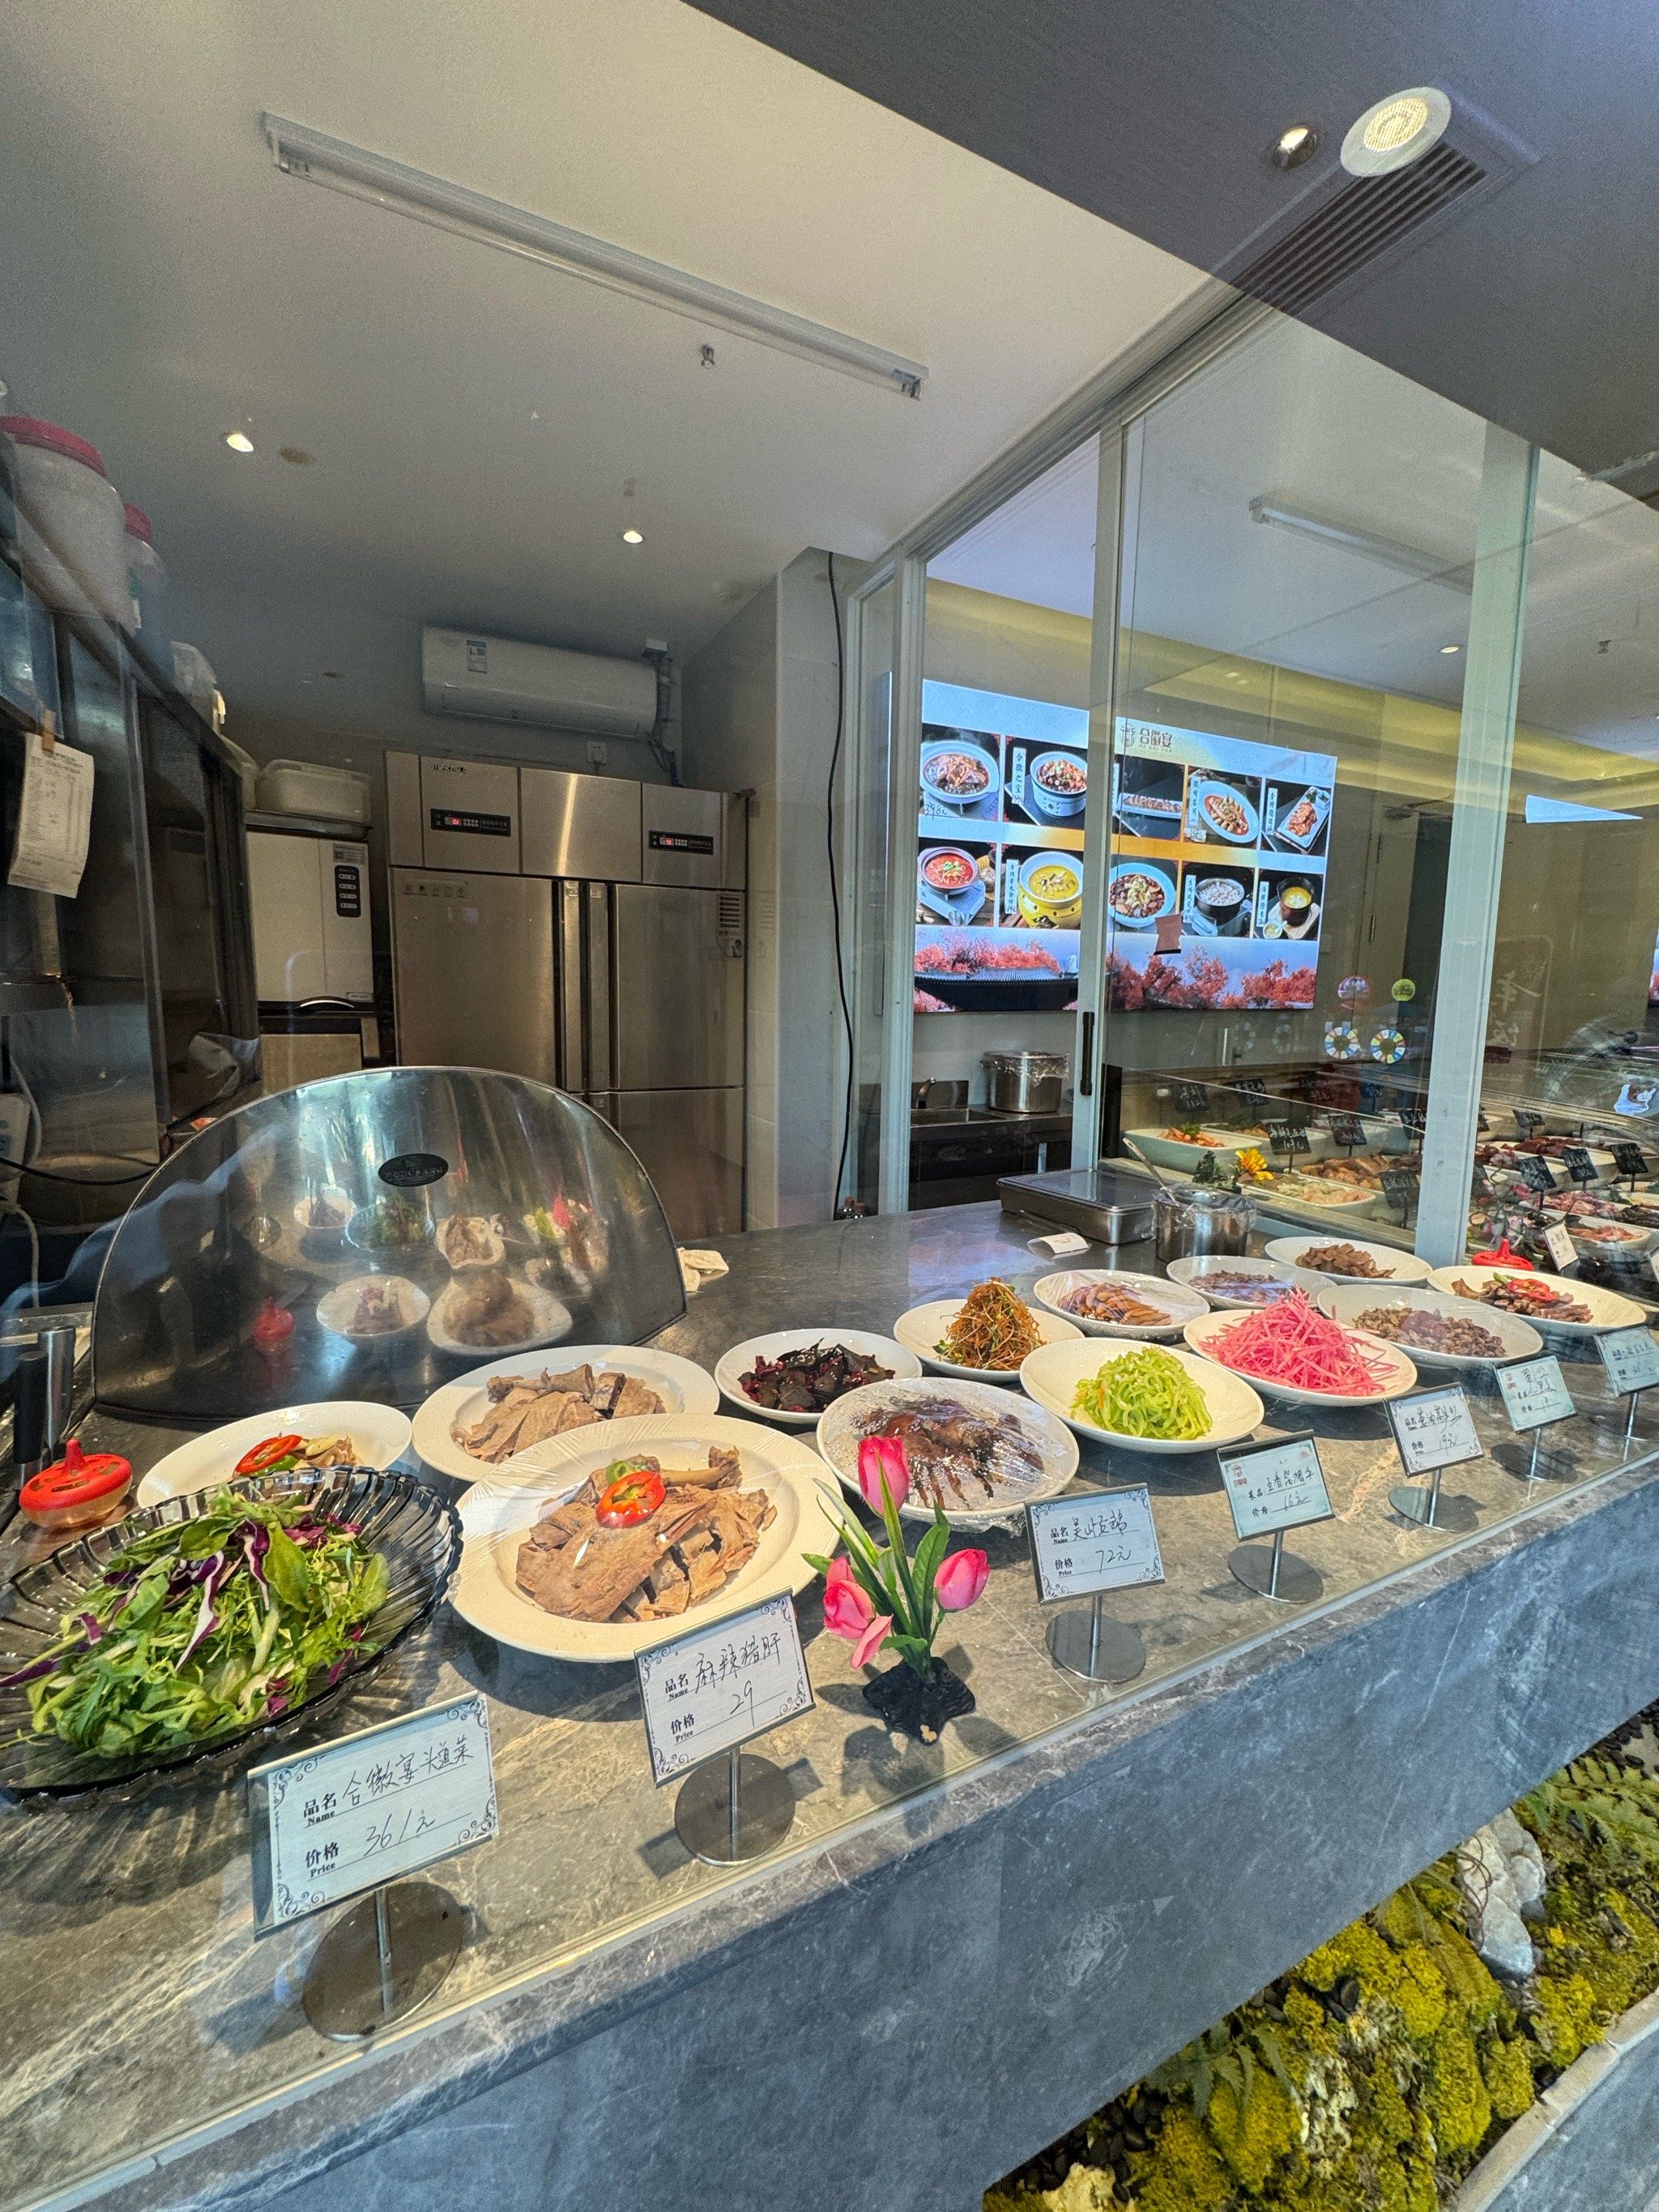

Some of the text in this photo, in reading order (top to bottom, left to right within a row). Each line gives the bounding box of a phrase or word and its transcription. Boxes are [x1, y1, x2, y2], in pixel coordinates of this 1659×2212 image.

[1051, 1527, 1068, 1538] 品名
[1055, 1557, 1073, 1569] 价格
[665, 1633, 781, 1695] 品名 麻辣猪肝
[668, 1687, 689, 1701] Name
[670, 1680, 756, 1735] 价格 29
[675, 1729, 694, 1743] Price
[303, 1792, 337, 1818] 品名
[307, 1809, 336, 1826] Name
[305, 1841, 339, 1868] 价格
[309, 1861, 337, 1878] Price
